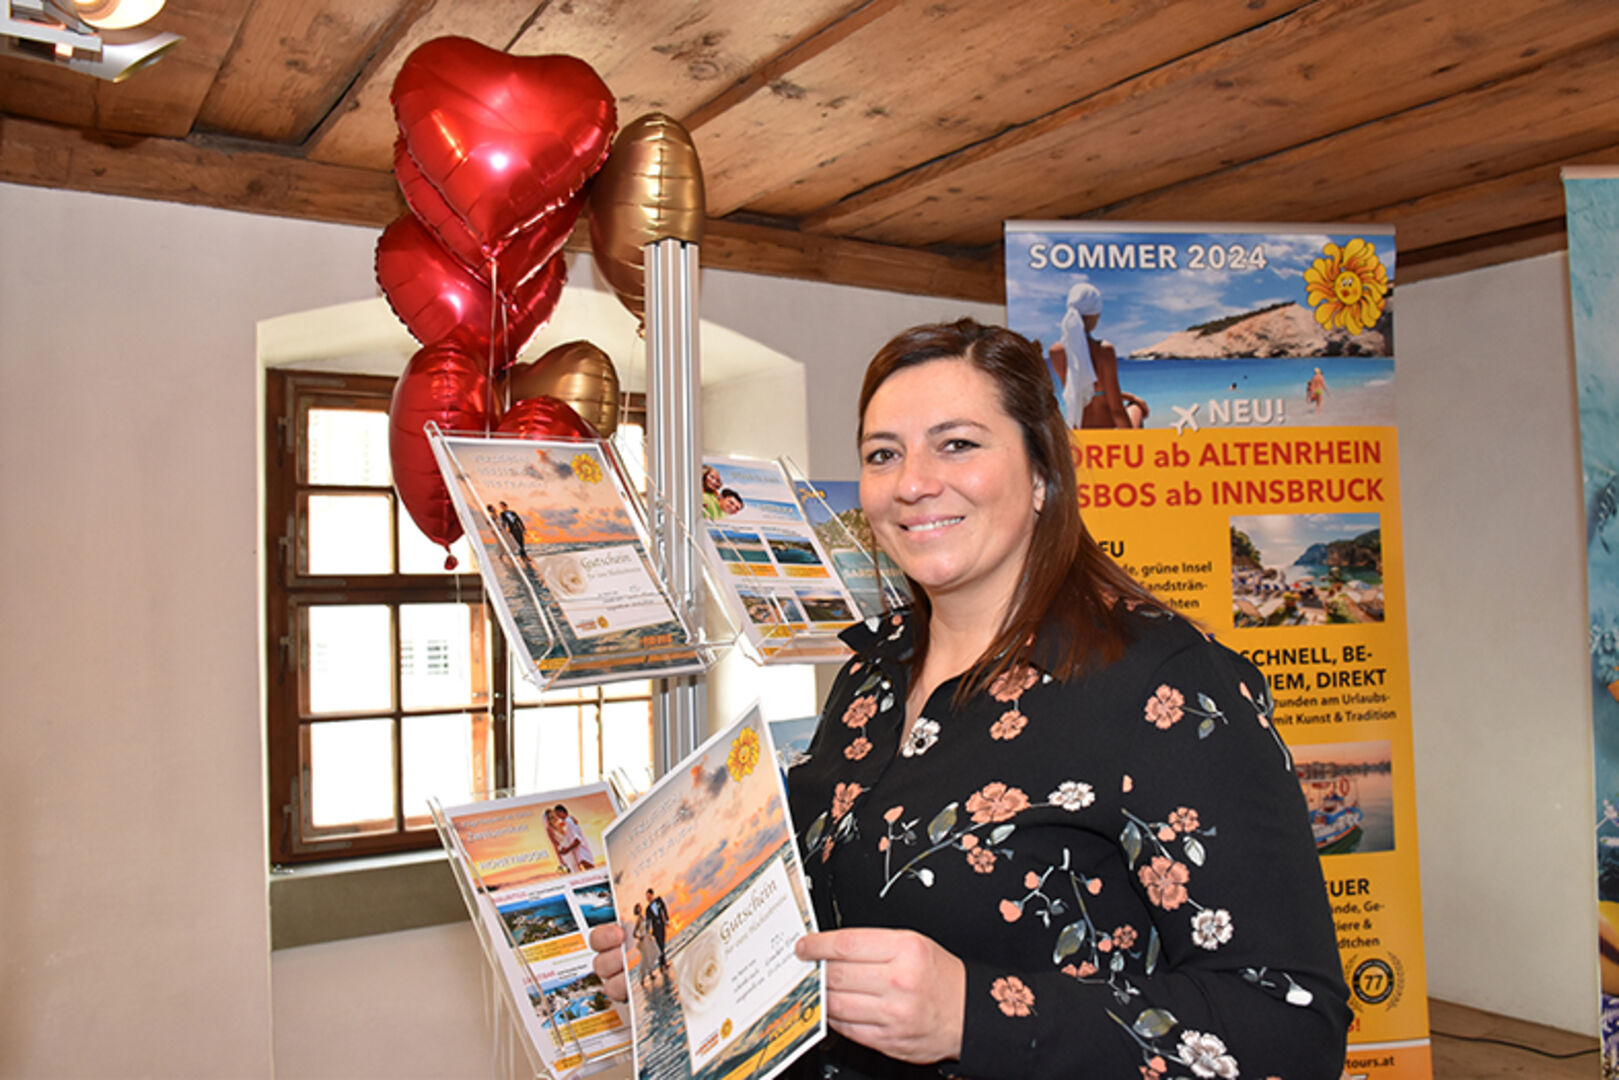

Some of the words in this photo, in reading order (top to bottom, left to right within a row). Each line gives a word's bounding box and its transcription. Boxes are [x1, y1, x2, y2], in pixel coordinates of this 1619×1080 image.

[1029, 243, 1178, 270] SOMMER
[1187, 244, 1267, 270] 2024
[1208, 398, 1286, 425] NEU!
[1070, 443, 1144, 469] ORFU
[1154, 442, 1190, 468] ab
[1199, 440, 1382, 467] ALTENRHEIN
[1077, 482, 1156, 508] SBOS
[1165, 480, 1203, 506] ab
[1211, 478, 1385, 505] INNSBRUCK
[1098, 541, 1124, 558] FU
[1342, 645, 1373, 664] BE-
[1316, 668, 1387, 689] DIREKT
[1320, 698, 1340, 707] am
[1295, 713, 1332, 725] Kunst
[1333, 711, 1343, 723] &
[1344, 709, 1397, 722] Tradition
[1325, 878, 1370, 898] UER
[719, 880, 778, 944] Gutschein
[1362, 918, 1373, 930] &
[1338, 936, 1381, 949] dtchen
[1364, 974, 1384, 991] 77
[1345, 1055, 1396, 1069] tours.at
